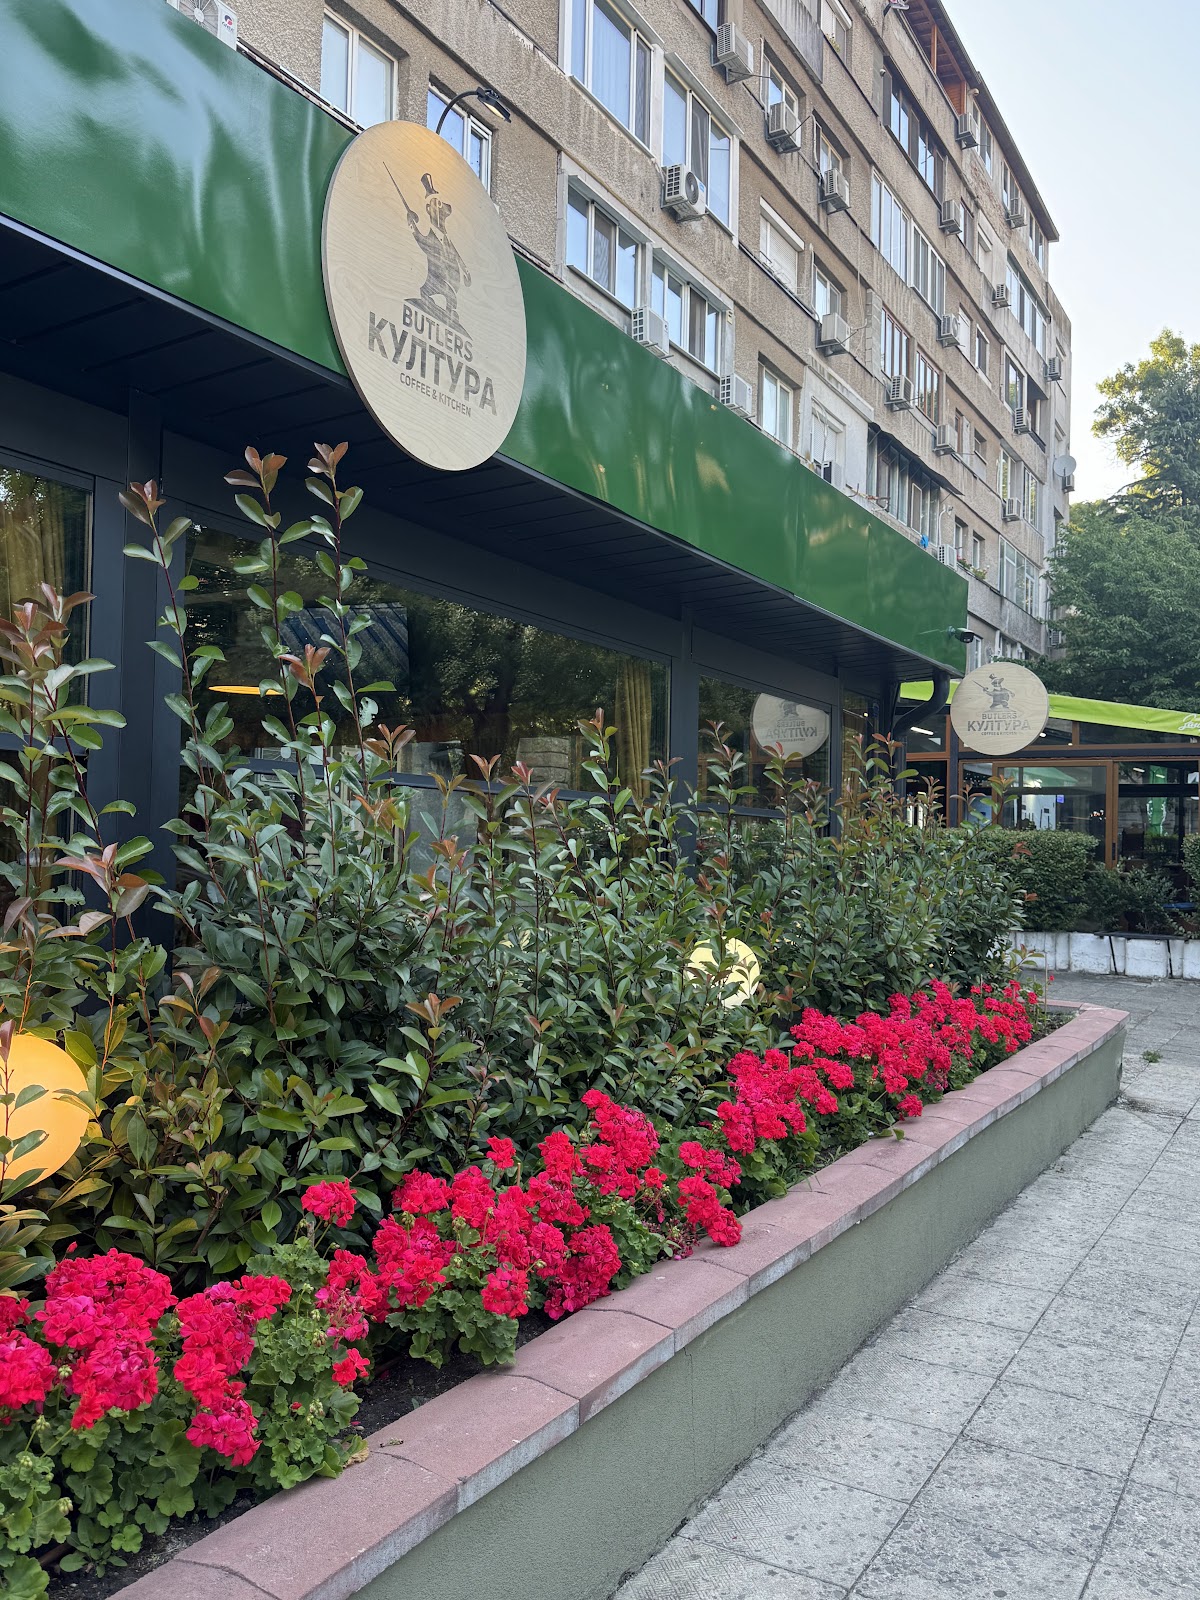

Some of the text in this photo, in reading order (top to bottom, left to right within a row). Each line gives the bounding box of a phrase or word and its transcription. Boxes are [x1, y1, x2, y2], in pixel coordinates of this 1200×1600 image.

[402, 304, 474, 363] BUTLERS
[367, 311, 498, 416] КУЛТУРА
[400, 372, 472, 417] COFFEE & KITCHEN
[967, 720, 1031, 731] КУЛТУРА
[981, 712, 1018, 720] BUTLERS
